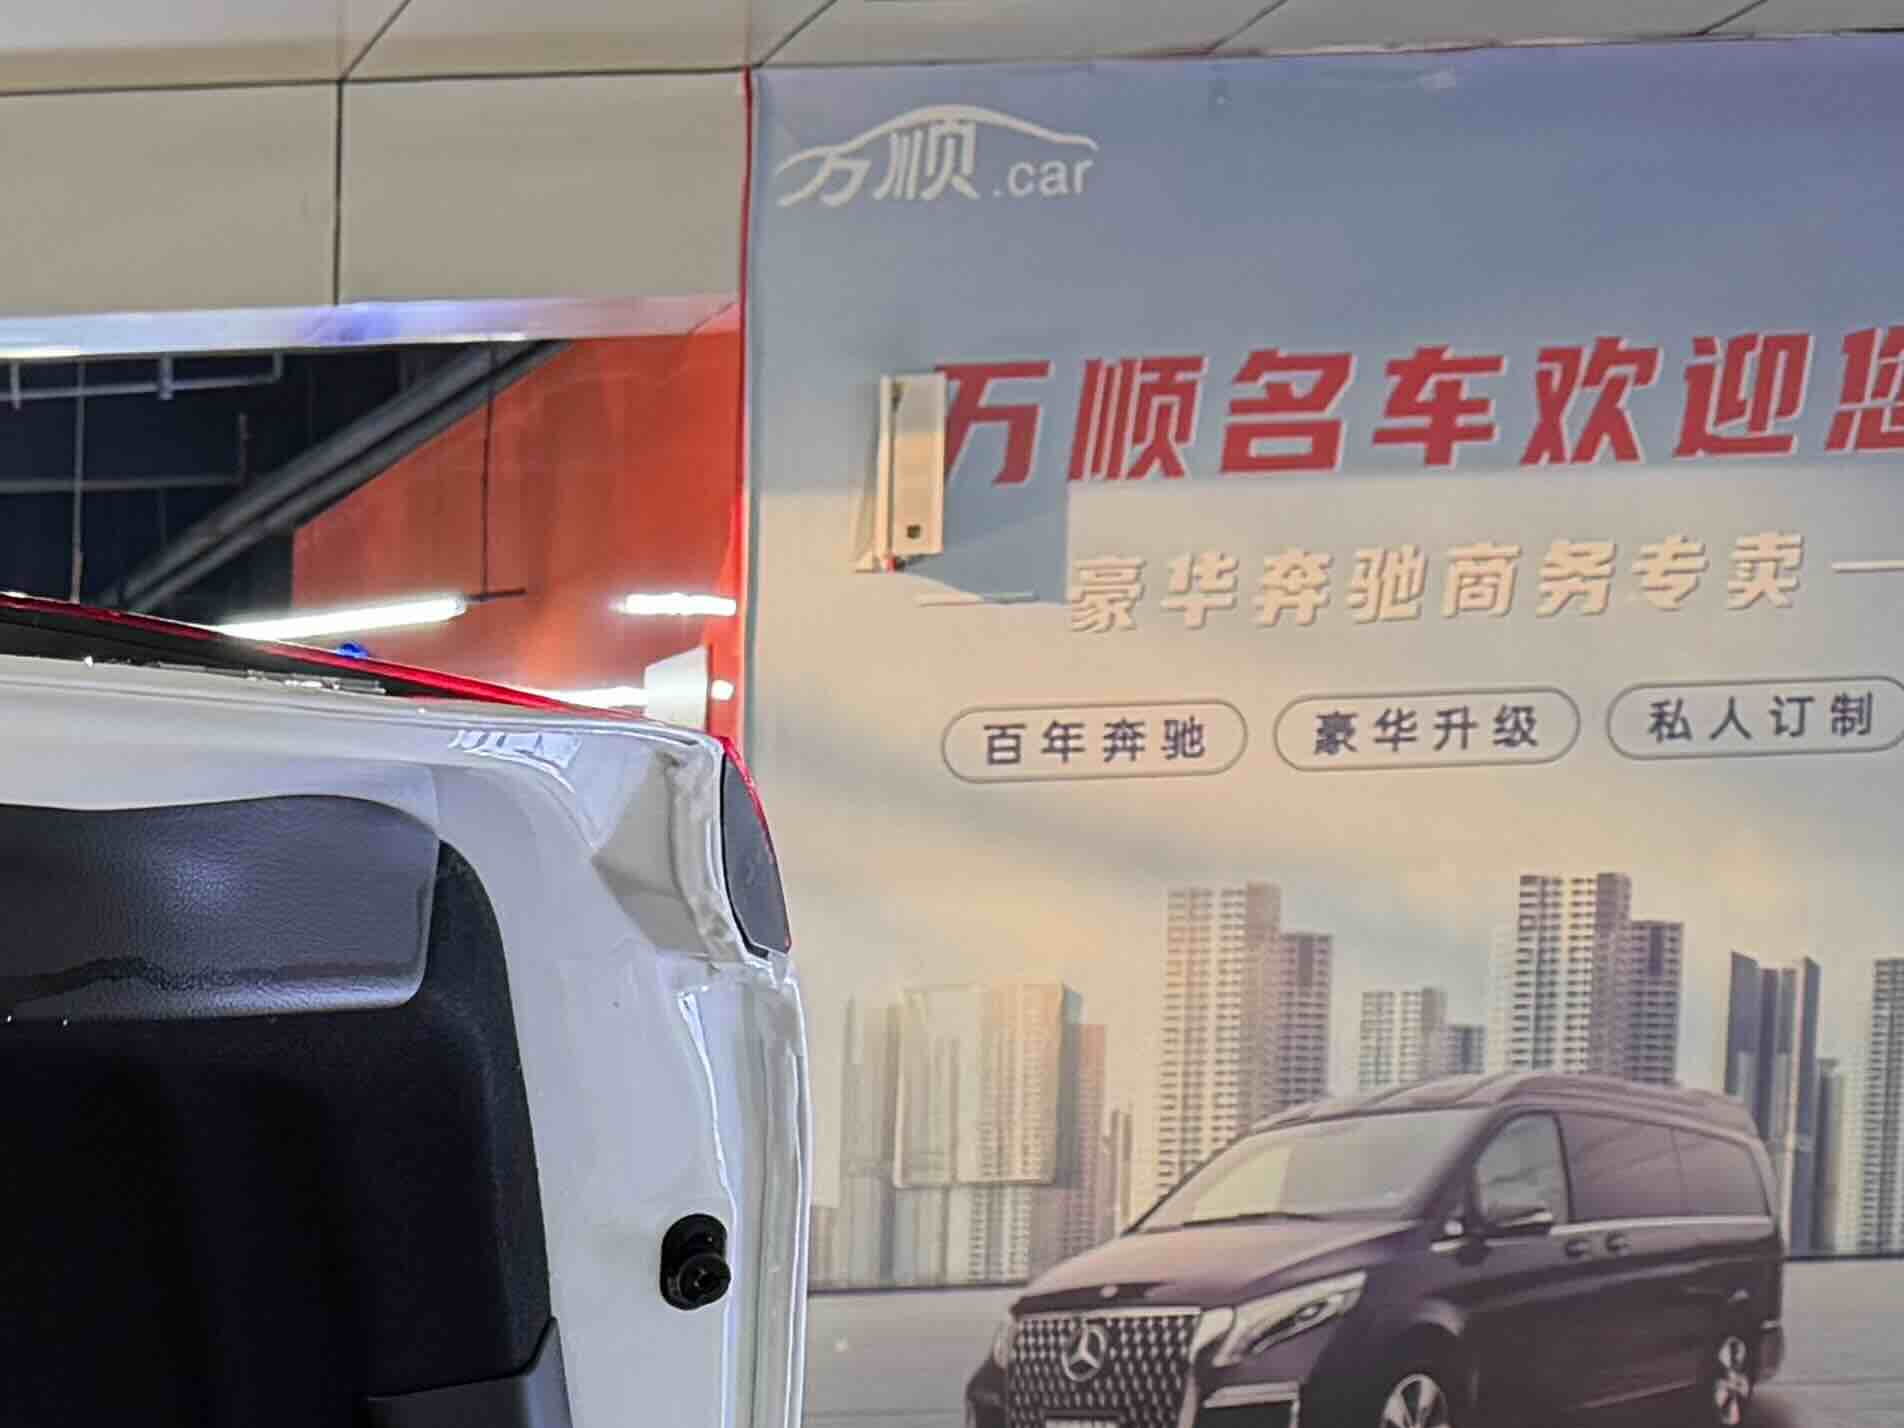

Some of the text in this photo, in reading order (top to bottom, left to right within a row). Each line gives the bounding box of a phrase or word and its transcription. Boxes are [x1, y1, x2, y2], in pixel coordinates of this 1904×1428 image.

[1065, 533, 1806, 634] 豪华奔驰商务专卖
[982, 715, 1211, 769] 百年奔驰
[1313, 704, 1542, 757] 豪华升级
[1648, 691, 1877, 744] 私人订制
